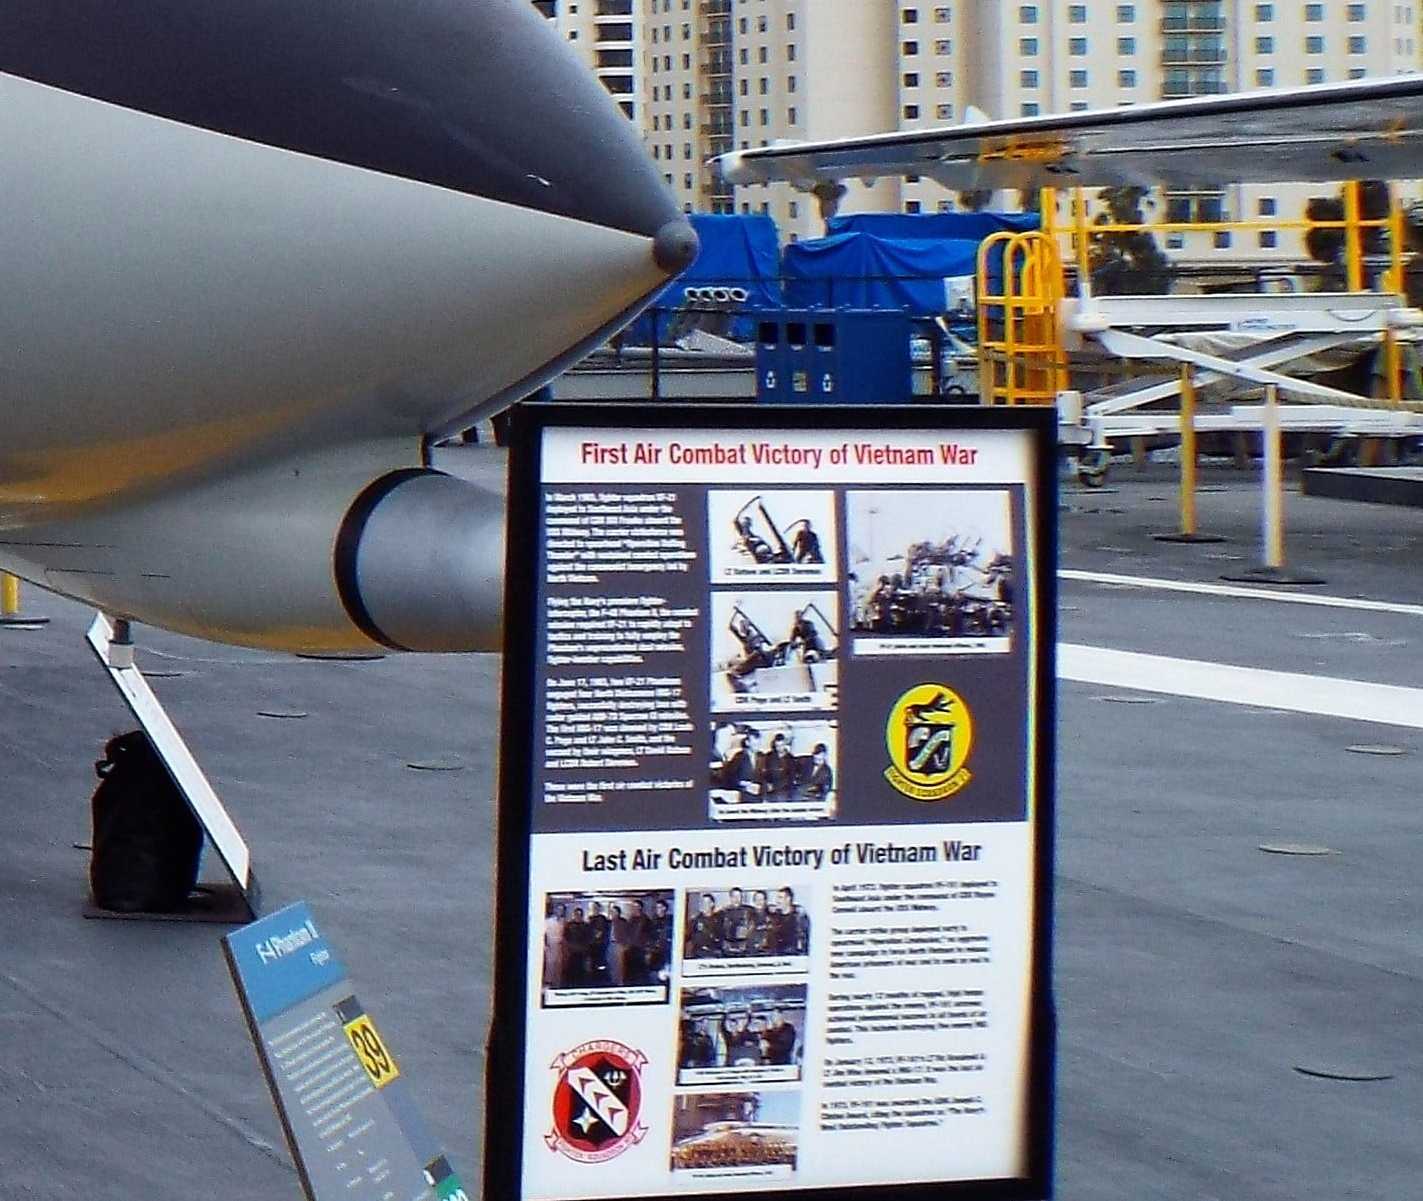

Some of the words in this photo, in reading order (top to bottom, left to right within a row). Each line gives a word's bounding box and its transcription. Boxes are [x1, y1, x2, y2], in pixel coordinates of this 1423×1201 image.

[581, 442, 628, 464] First
[633, 442, 662, 464] Air
[669, 442, 746, 464] Combat
[752, 443, 822, 469] Victory
[830, 444, 849, 465] of
[854, 444, 934, 465] Vietnam
[939, 444, 978, 465] War
[583, 849, 627, 871] Last
[632, 848, 662, 870] Air
[668, 847, 747, 869] Combat
[752, 845, 824, 870] Victory
[831, 843, 851, 865] of
[856, 842, 937, 864] Vietnam
[943, 841, 982, 861] War
